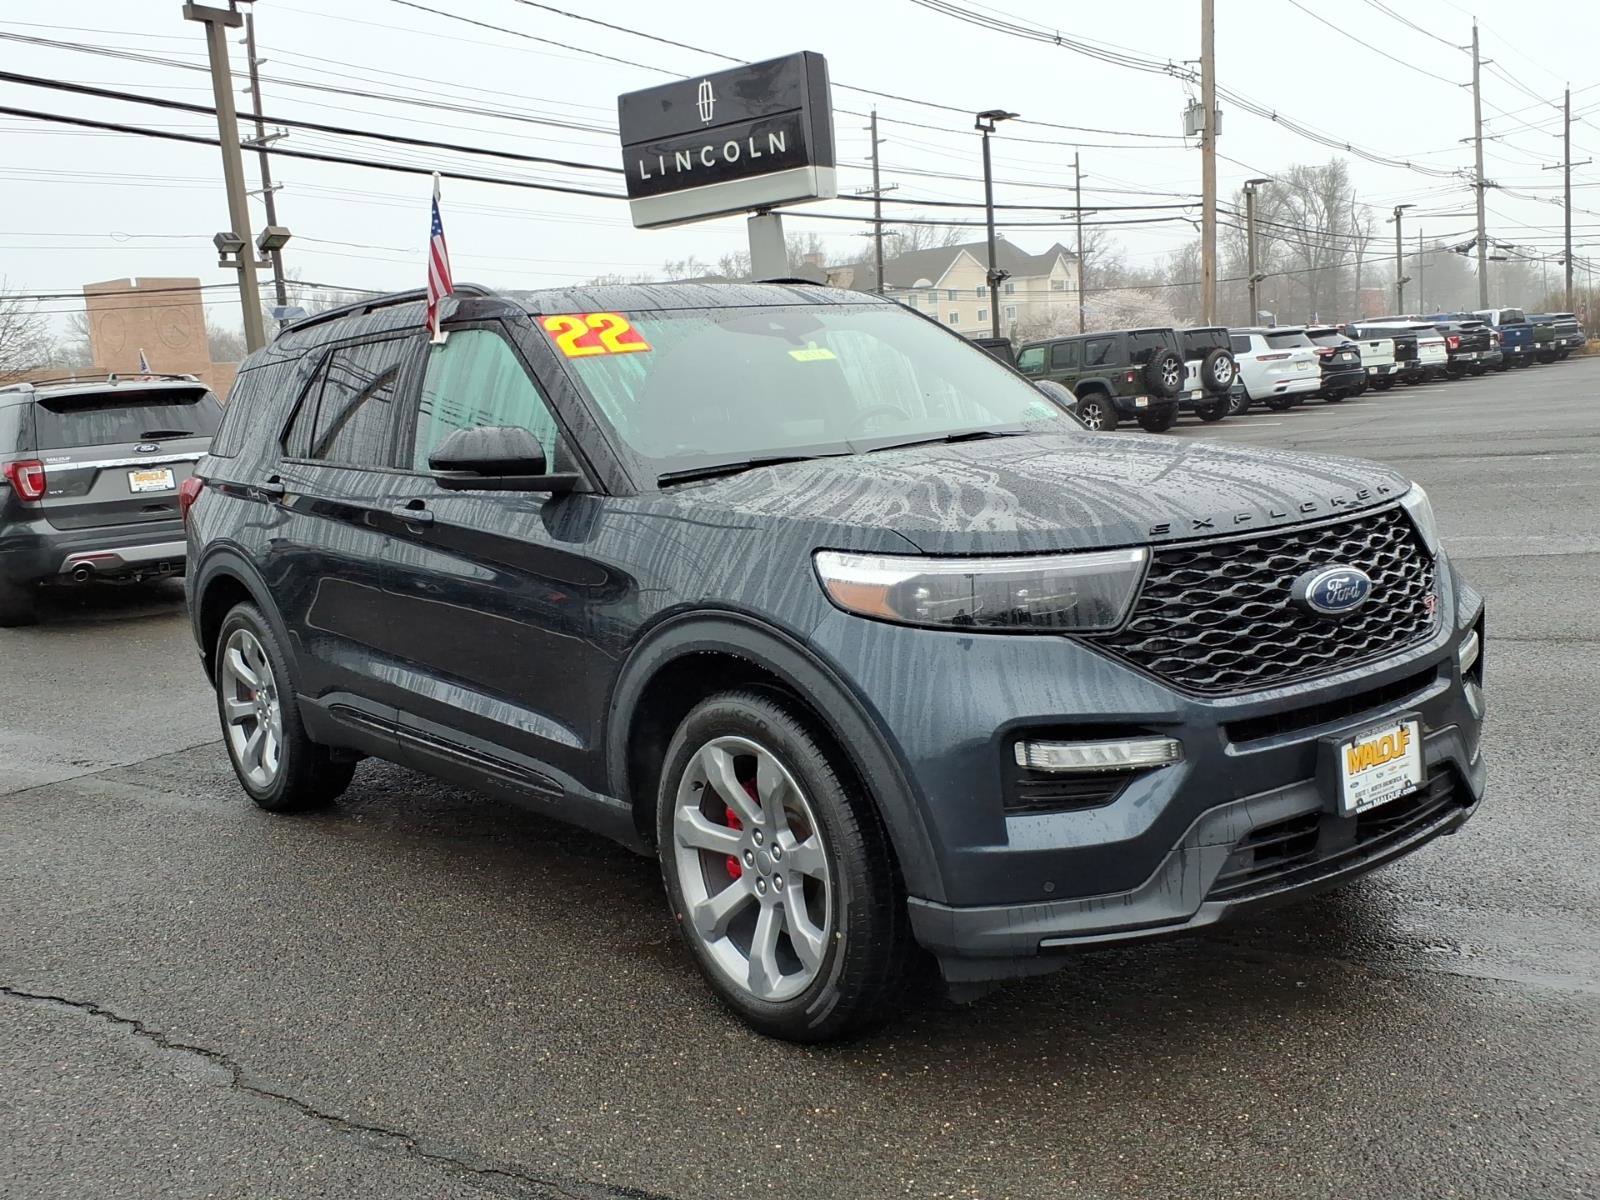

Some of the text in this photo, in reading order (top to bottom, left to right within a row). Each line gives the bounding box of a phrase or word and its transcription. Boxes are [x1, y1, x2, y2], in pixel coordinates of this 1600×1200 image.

[639, 130, 787, 180] LINCOLN
[543, 312, 648, 357] 22
[1149, 483, 1392, 536] EXPLORER
[1326, 576, 1362, 604] Ford
[1346, 728, 1411, 776] MALOUF
